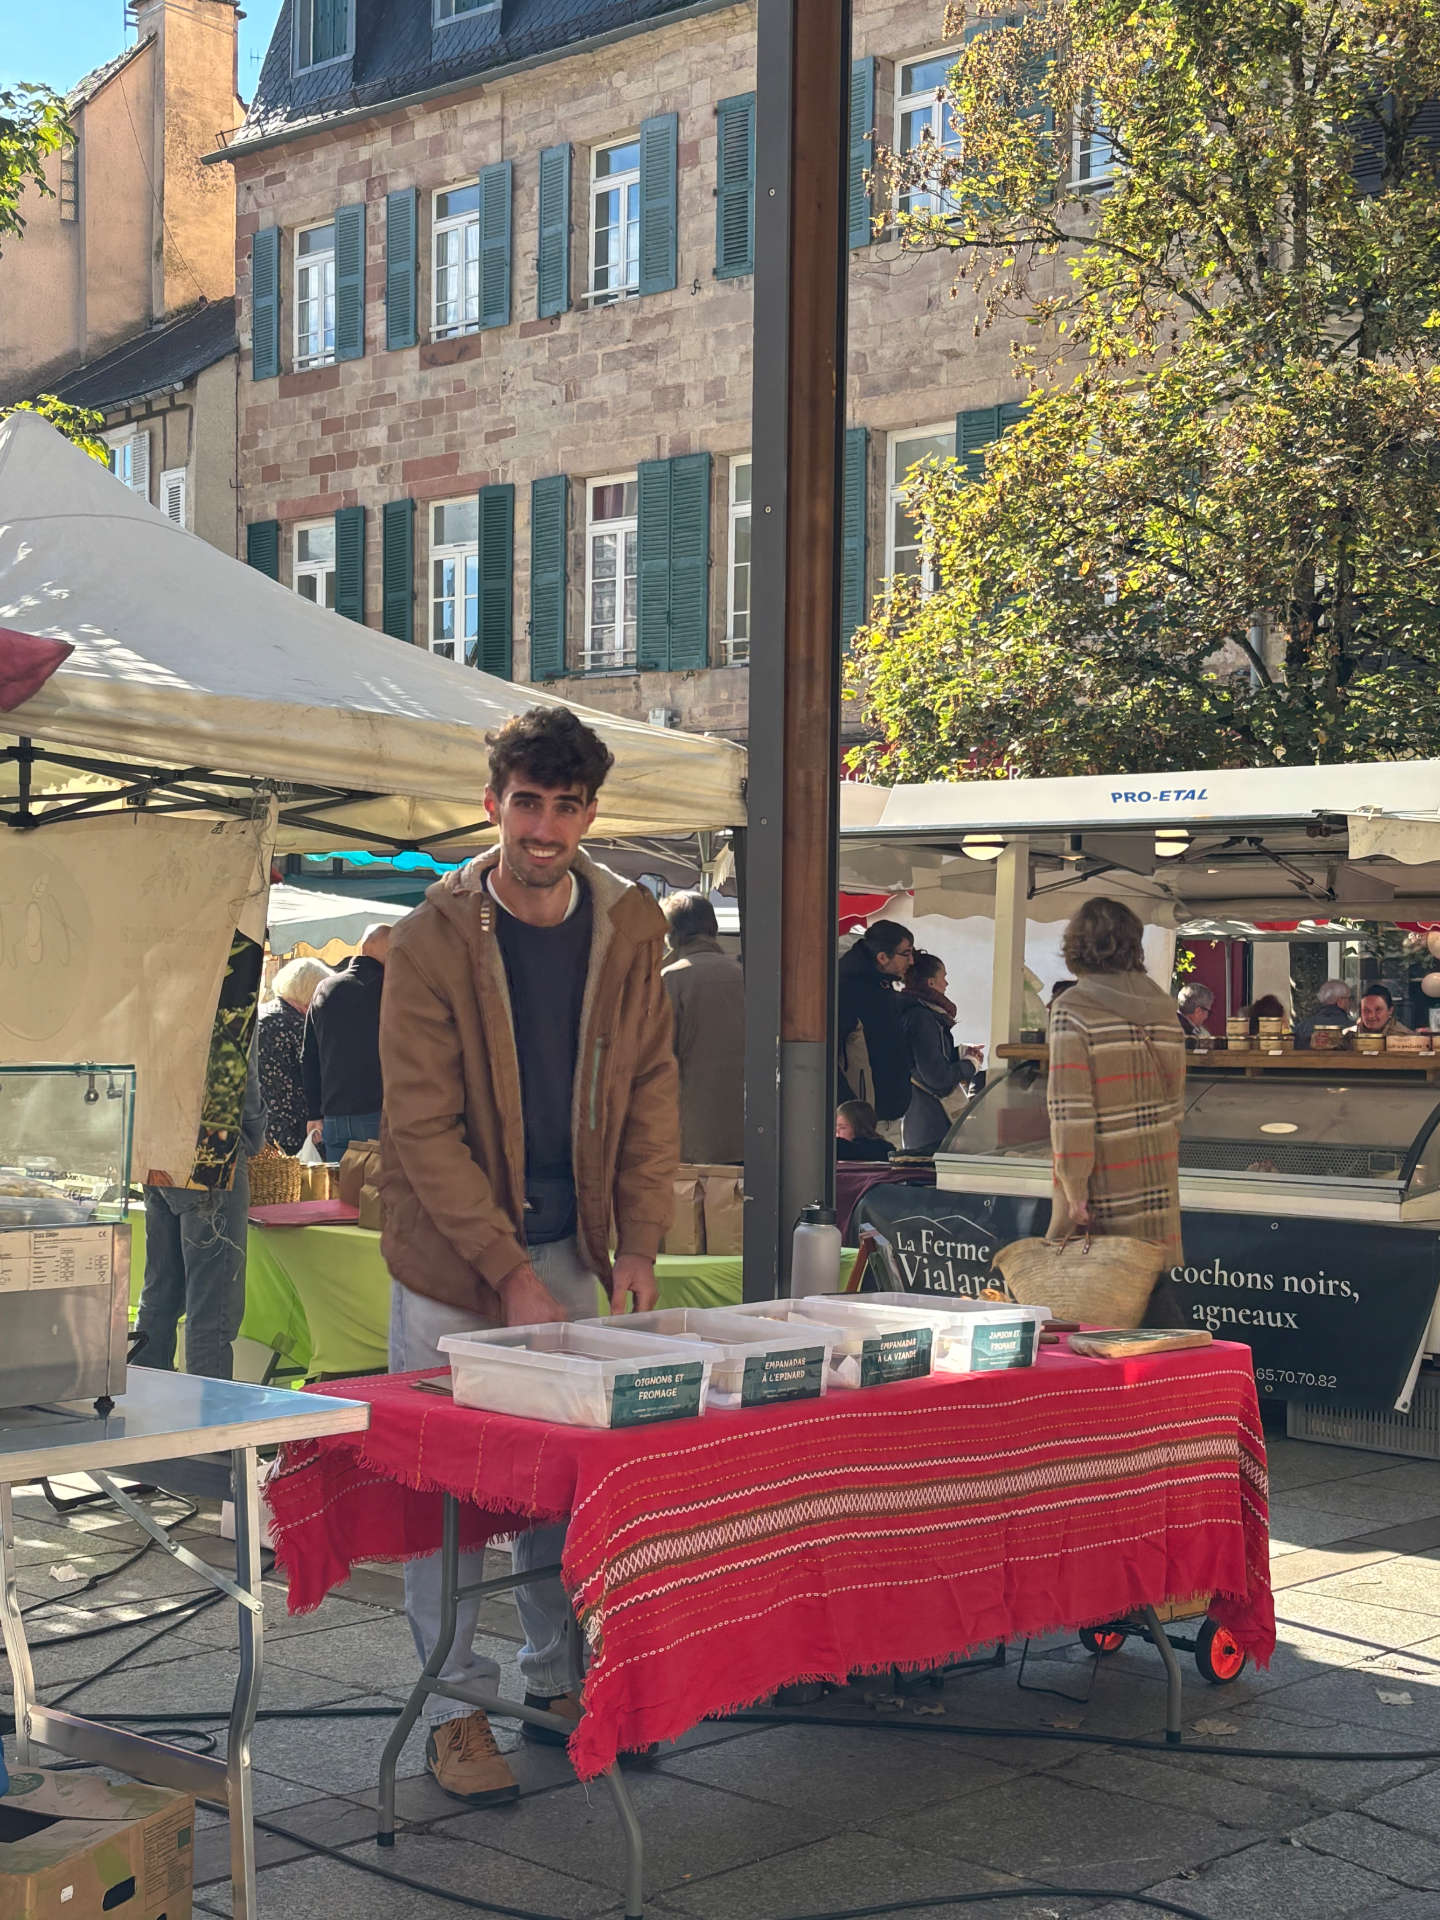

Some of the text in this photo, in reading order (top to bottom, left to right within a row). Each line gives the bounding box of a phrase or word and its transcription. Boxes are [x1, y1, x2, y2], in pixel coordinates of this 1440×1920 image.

[1111, 789, 1208, 803] PRO-ETAL
[896, 1229, 990, 1263] La Ferme
[1170, 1258, 1359, 1304] cochons noirs,
[1192, 1303, 1299, 1331] agneaux
[988, 1329, 1021, 1340] JAMBON ET
[880, 1338, 917, 1350] EMPANADAS
[893, 1350, 917, 1361] VIANDE
[765, 1357, 806, 1370] EMPANADAS
[634, 1373, 685, 1388] OIGNONS ET
[761, 1373, 768, 1383] À
[638, 1388, 678, 1400] FROMAGE
